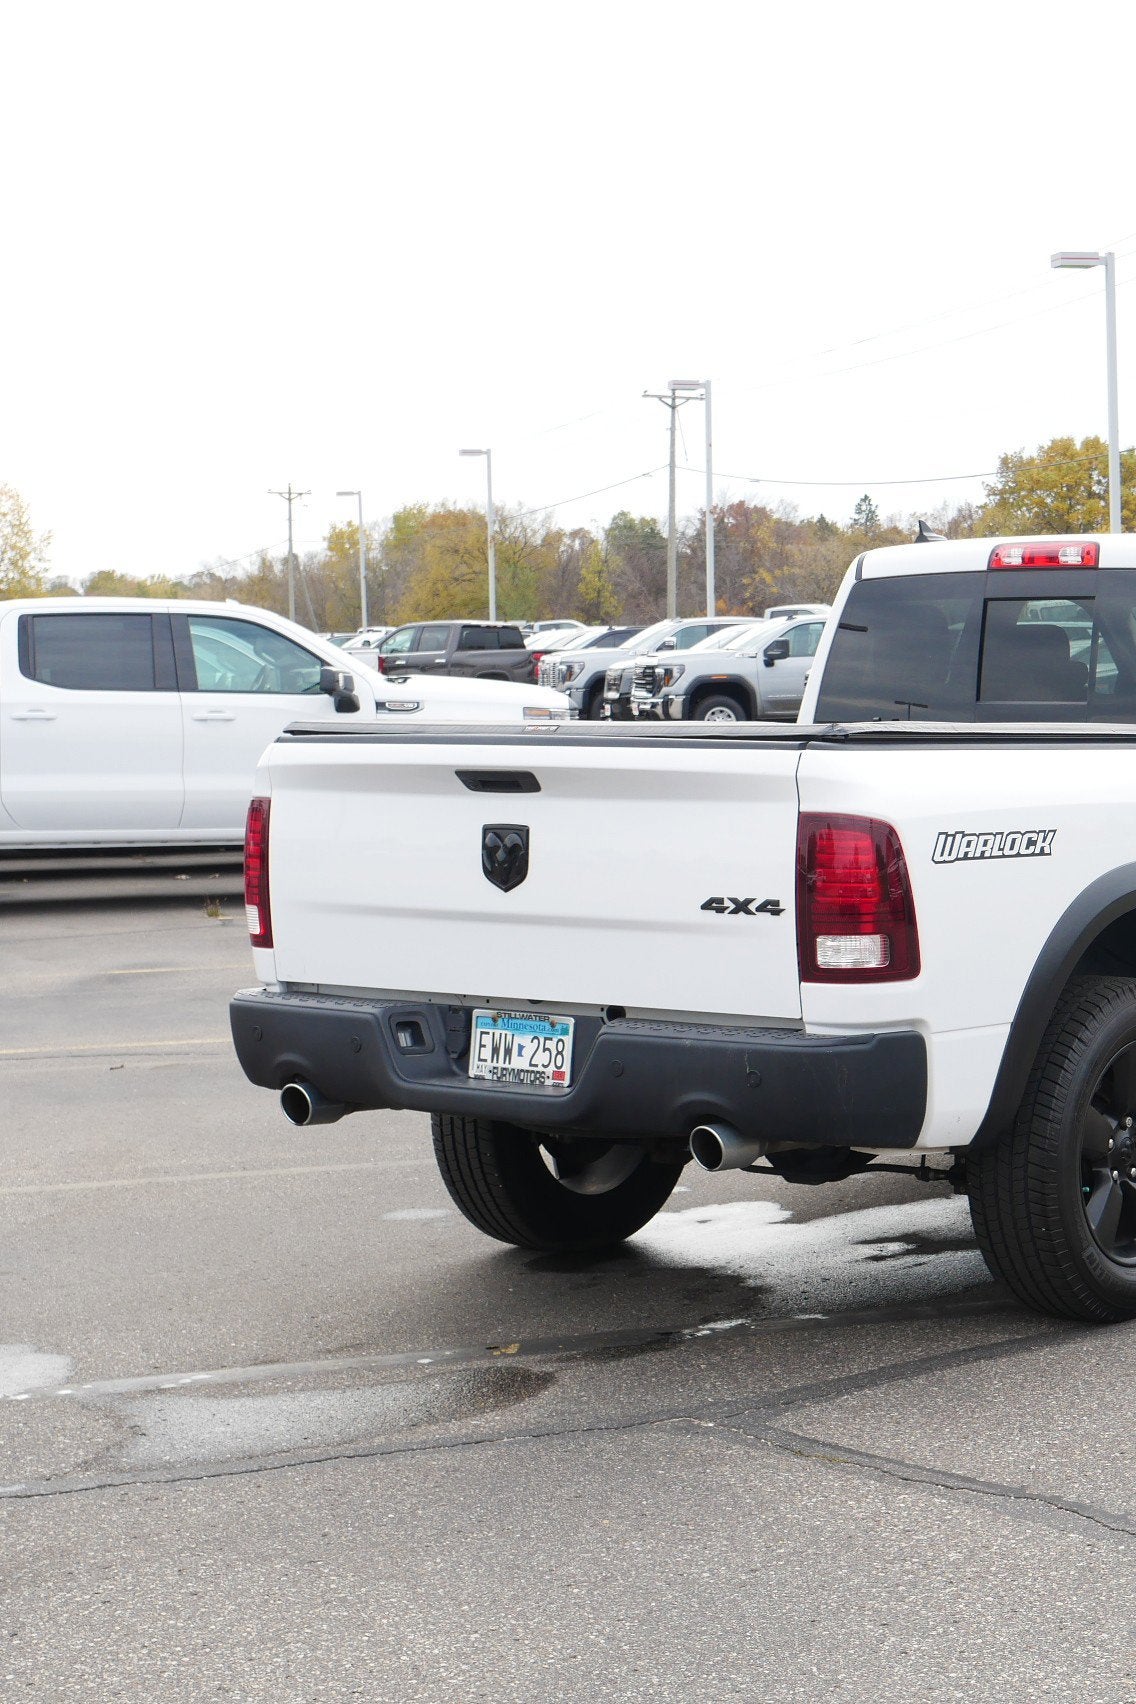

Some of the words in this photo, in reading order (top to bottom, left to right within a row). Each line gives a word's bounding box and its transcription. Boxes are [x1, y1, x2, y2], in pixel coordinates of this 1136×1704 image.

[496, 1011, 550, 1021] STILLWATER
[477, 1031, 515, 1065] EWW
[528, 1036, 565, 1070] 258
